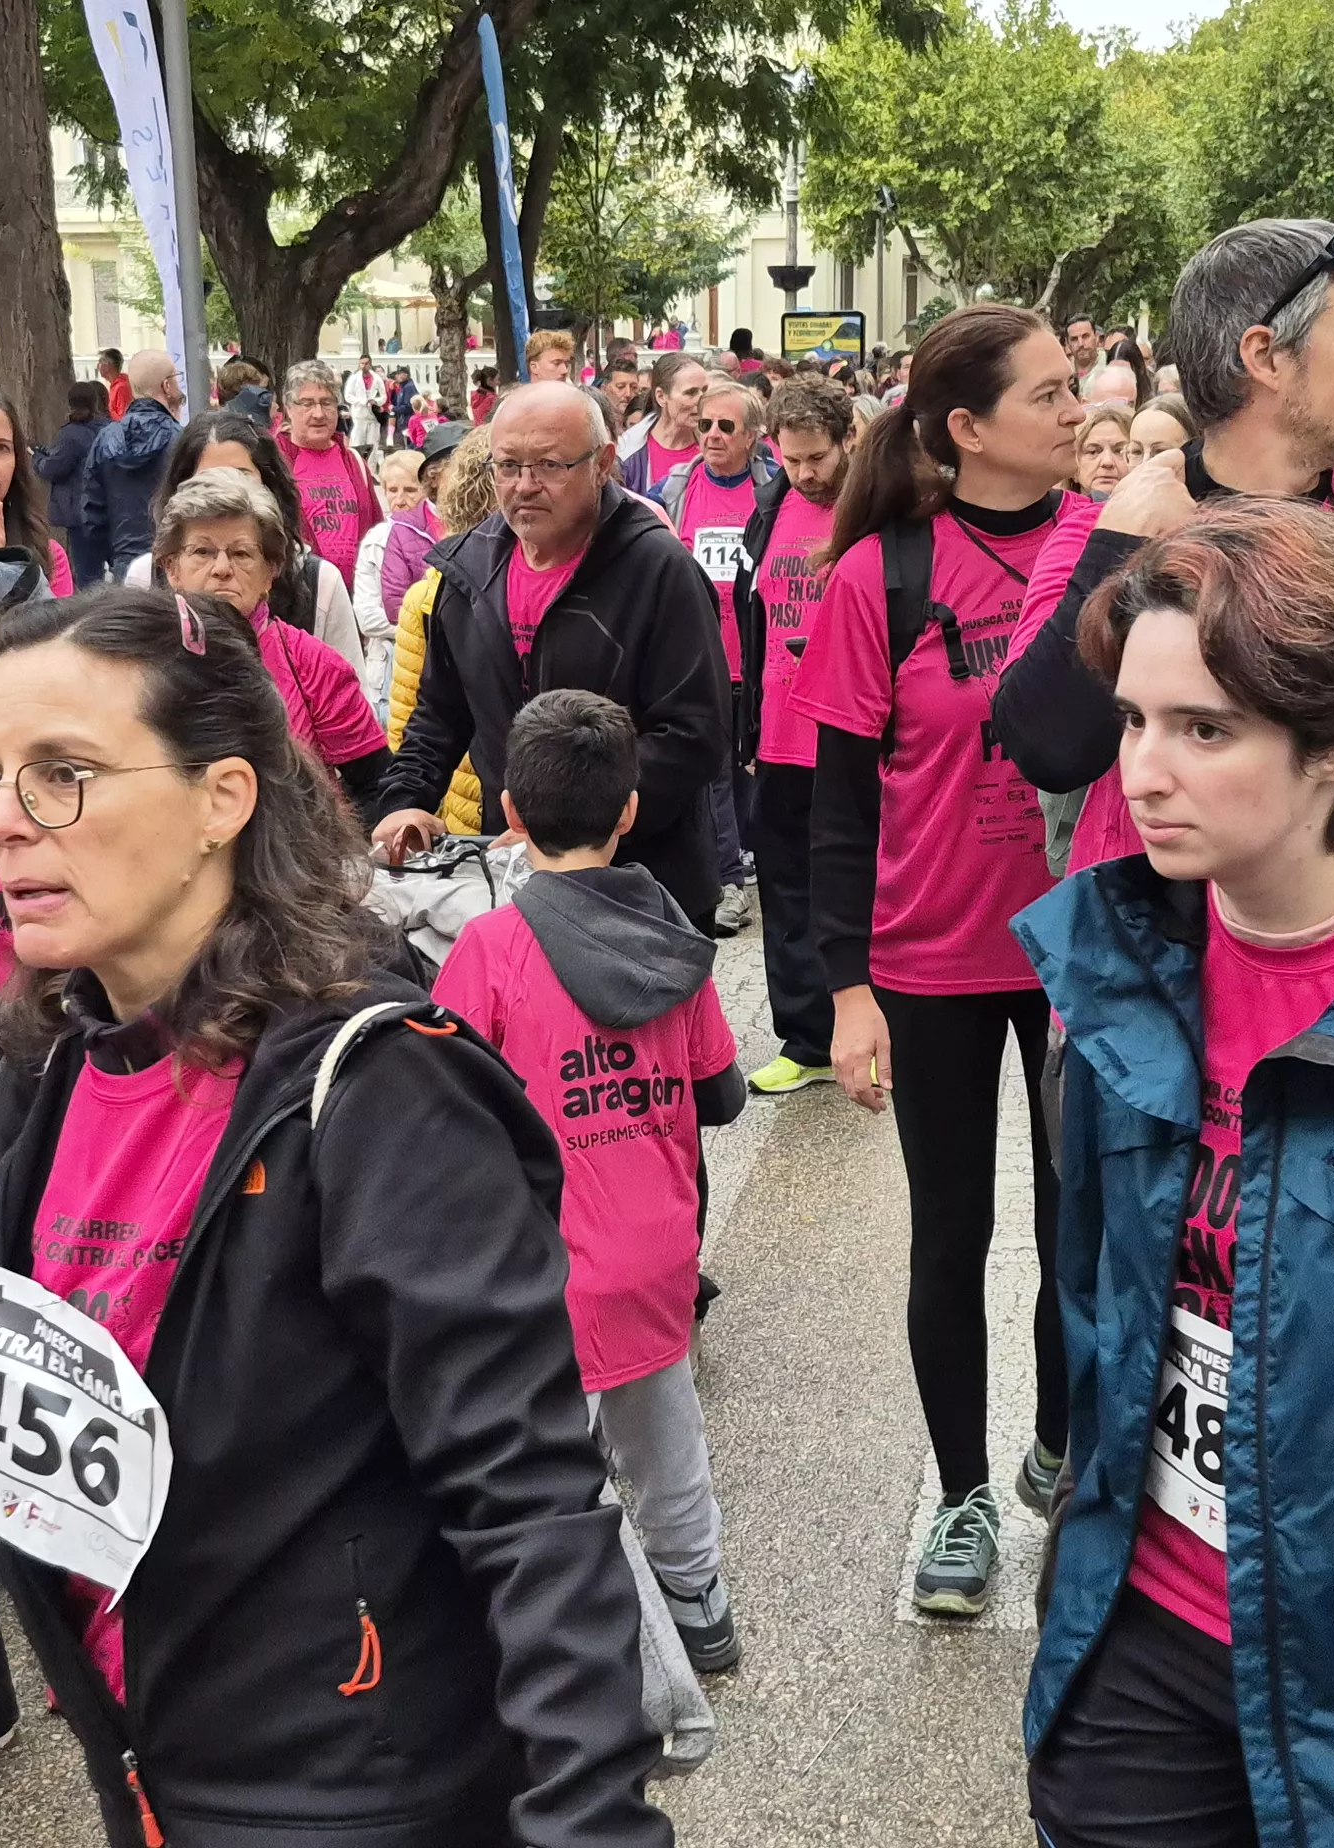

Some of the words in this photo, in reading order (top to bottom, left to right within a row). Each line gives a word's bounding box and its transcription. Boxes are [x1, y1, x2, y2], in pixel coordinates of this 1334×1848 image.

[702, 546, 744, 566] 114
[788, 580, 804, 601] EN
[769, 603, 802, 628] PASO
[961, 613, 1004, 631] HUESCA
[559, 1035, 636, 1082] alto
[33, 1319, 84, 1364] HUESCA
[47, 1350, 71, 1379] EL
[1206, 1371, 1230, 1397] EL
